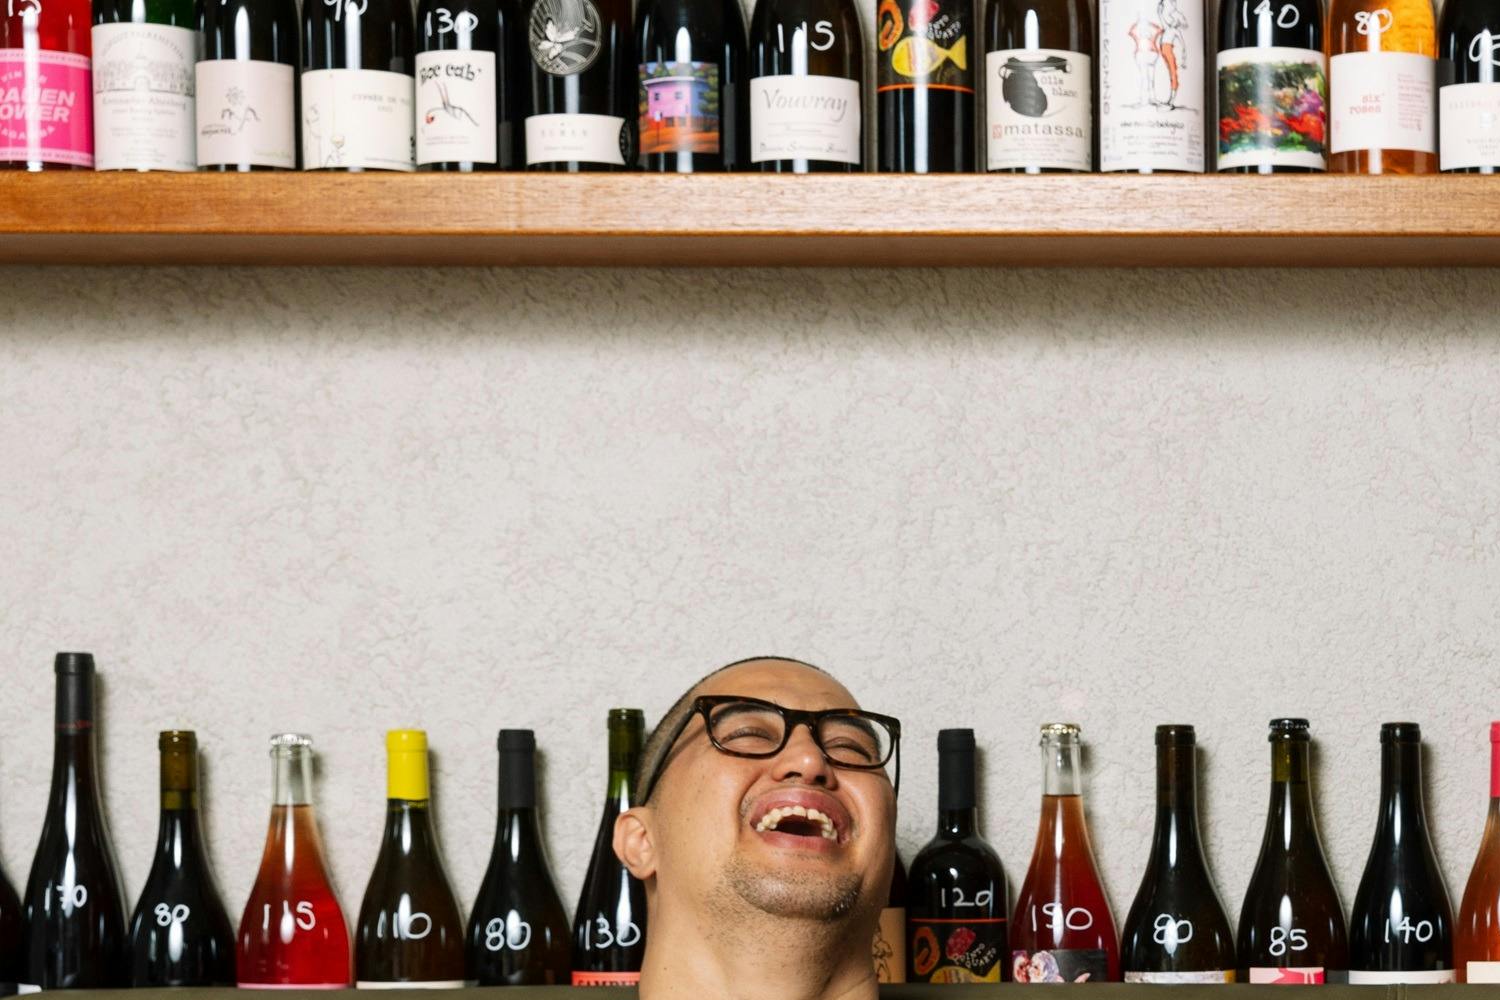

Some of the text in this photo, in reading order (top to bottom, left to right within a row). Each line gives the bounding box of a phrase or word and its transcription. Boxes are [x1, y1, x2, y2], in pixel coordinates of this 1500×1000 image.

[426, 8, 479, 37] 130
[777, 20, 836, 52] 115
[1354, 9, 1393, 35] 80
[762, 88, 848, 123] Vouvray
[1004, 123, 1084, 139] matassa
[941, 887, 992, 908] 120
[154, 903, 190, 927] 80
[263, 900, 316, 930] 115
[377, 911, 432, 939] 110
[1153, 914, 1193, 944] 80
[485, 918, 531, 951] 80
[585, 917, 641, 950] 130
[1269, 926, 1308, 956] 85
[1384, 916, 1433, 944] 140
